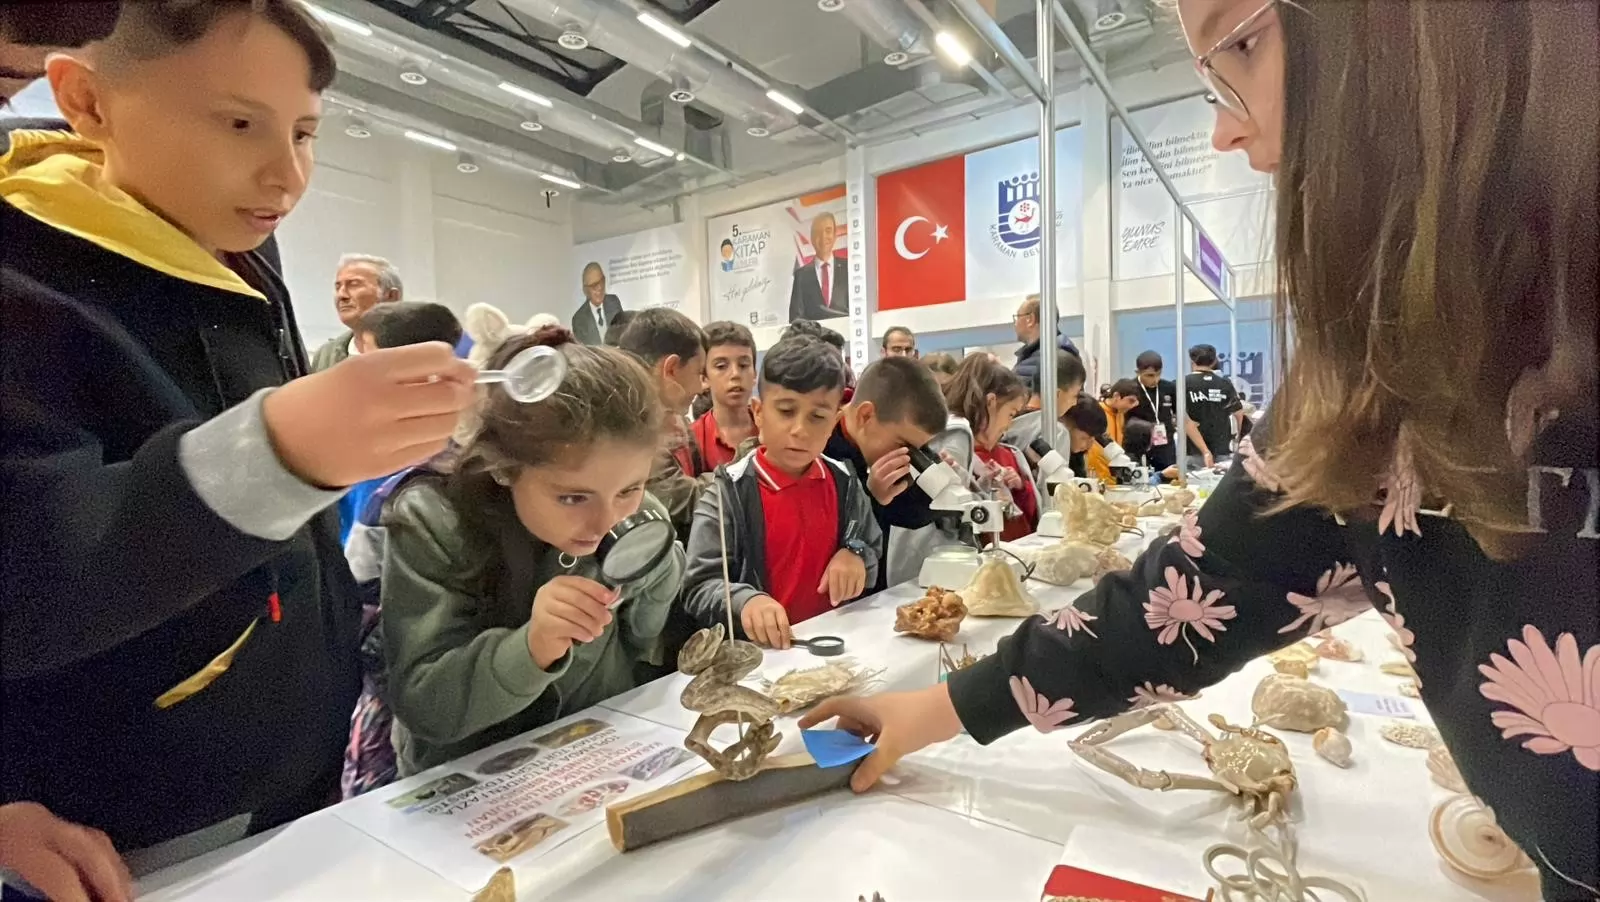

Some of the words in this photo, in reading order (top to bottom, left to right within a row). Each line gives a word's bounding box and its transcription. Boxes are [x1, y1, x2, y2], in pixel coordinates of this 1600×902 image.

[732, 224, 742, 237] 5.
[733, 230, 771, 245] KARAMAN
[990, 223, 1017, 258] KARAMAN
[606, 740, 664, 767] KARAMAN
